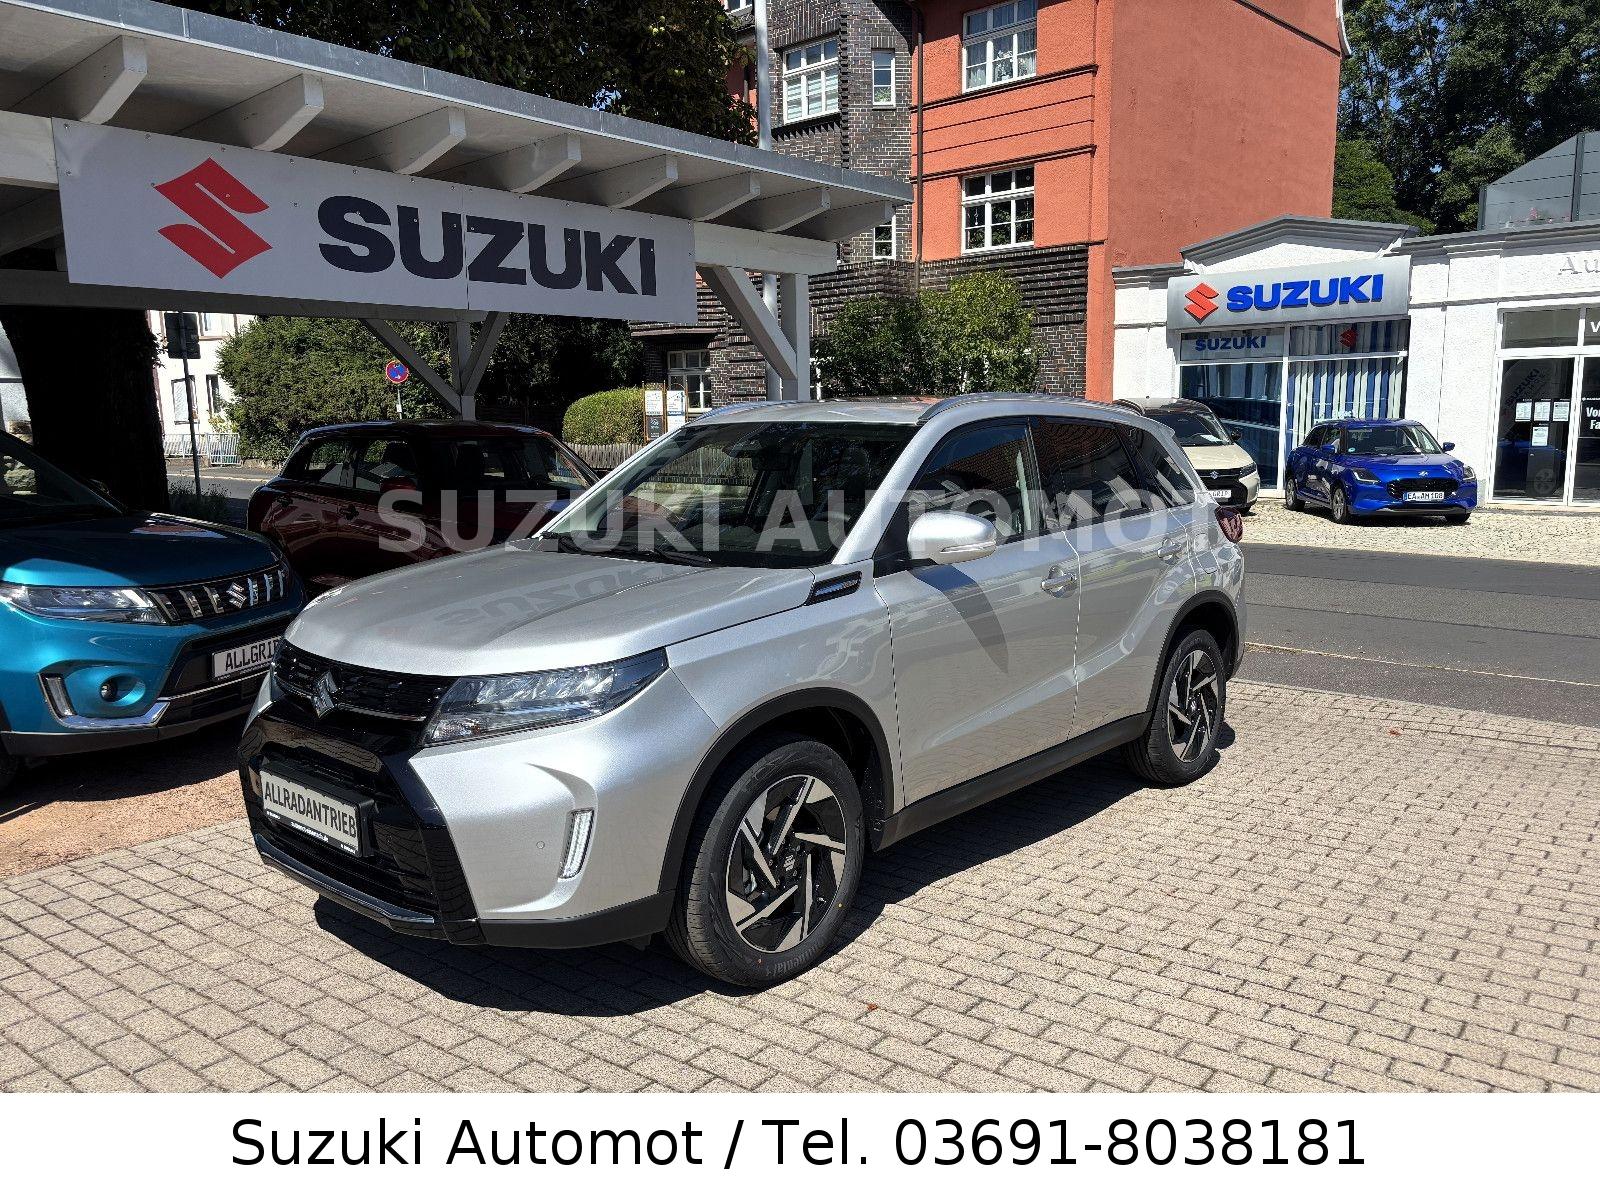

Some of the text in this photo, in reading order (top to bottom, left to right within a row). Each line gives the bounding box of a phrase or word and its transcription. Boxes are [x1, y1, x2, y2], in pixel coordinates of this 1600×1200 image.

[317, 195, 657, 297] SUZUKI
[1226, 274, 1384, 312] SUZUKI
[1195, 336, 1267, 352] SUZUKI
[264, 781, 357, 839] ALLRADANTRIEB
